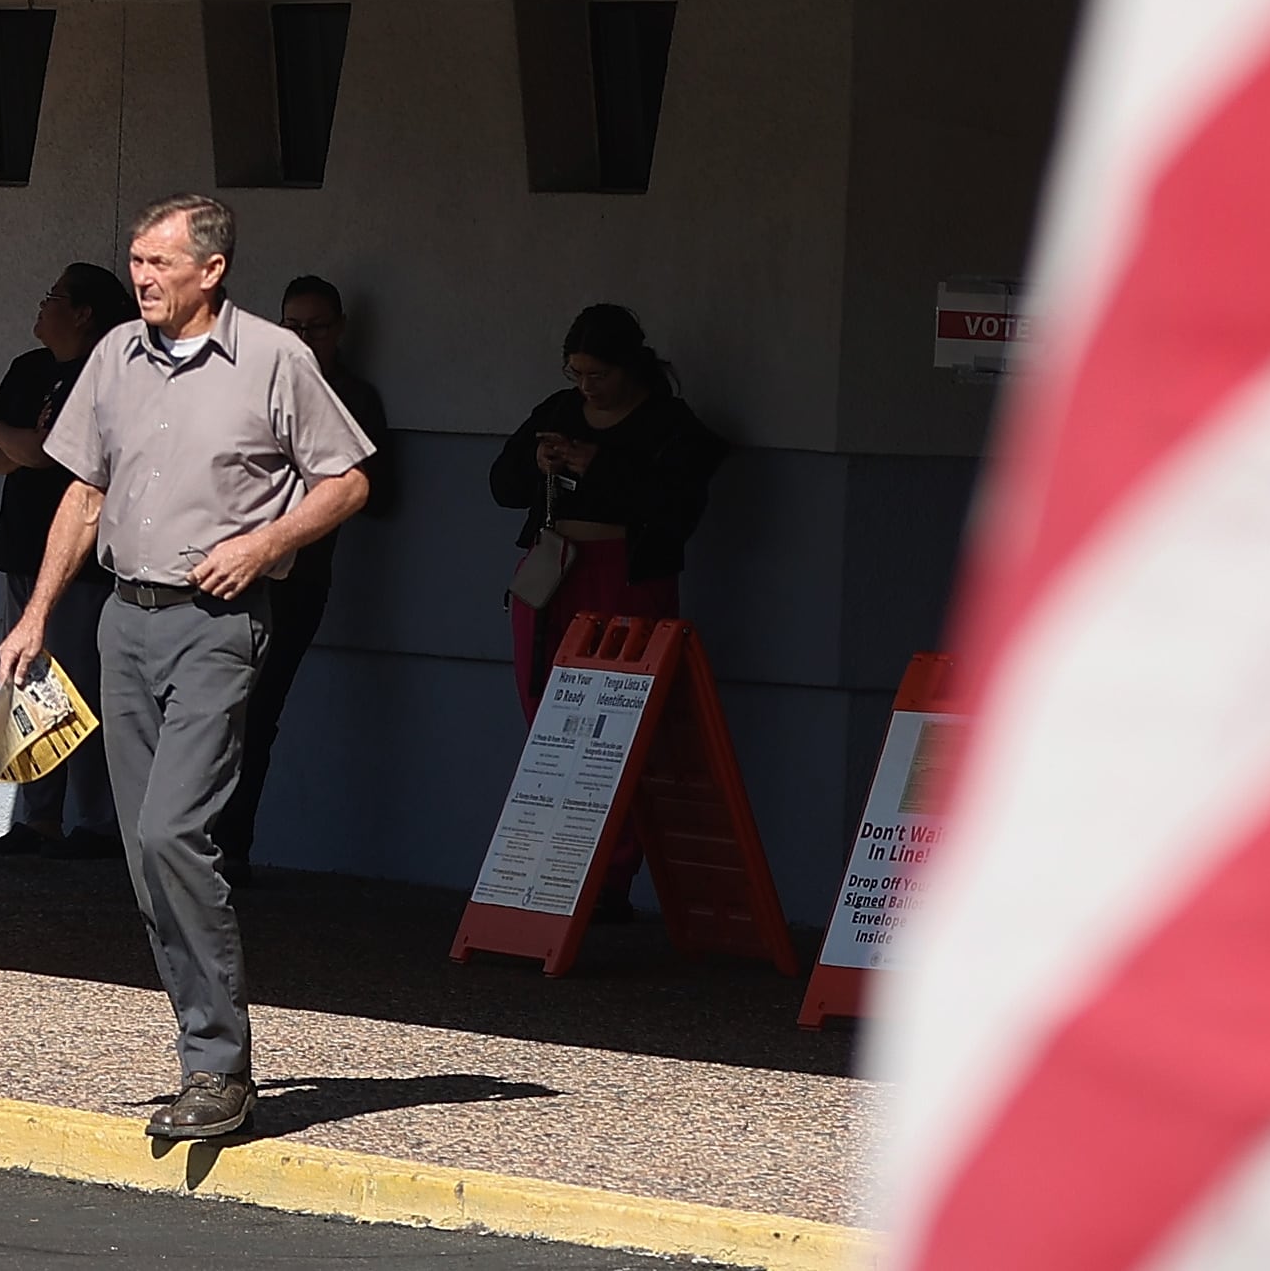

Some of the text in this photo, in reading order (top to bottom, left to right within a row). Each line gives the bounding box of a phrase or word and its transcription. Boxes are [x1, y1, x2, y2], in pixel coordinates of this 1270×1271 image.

[964, 315, 1031, 339] VOTE
[558, 671, 593, 685] Have Your
[604, 676, 624, 692] Tenga
[624, 678, 640, 691] Lista
[554, 689, 586, 706] ID Ready
[910, 826, 945, 843] Wai
[868, 843, 931, 863] In Line!
[848, 874, 878, 892] Drop
[881, 877, 901, 890] Off
[844, 892, 887, 909] Signed
[851, 911, 906, 929] Envelope
[855, 929, 893, 944] Inside
